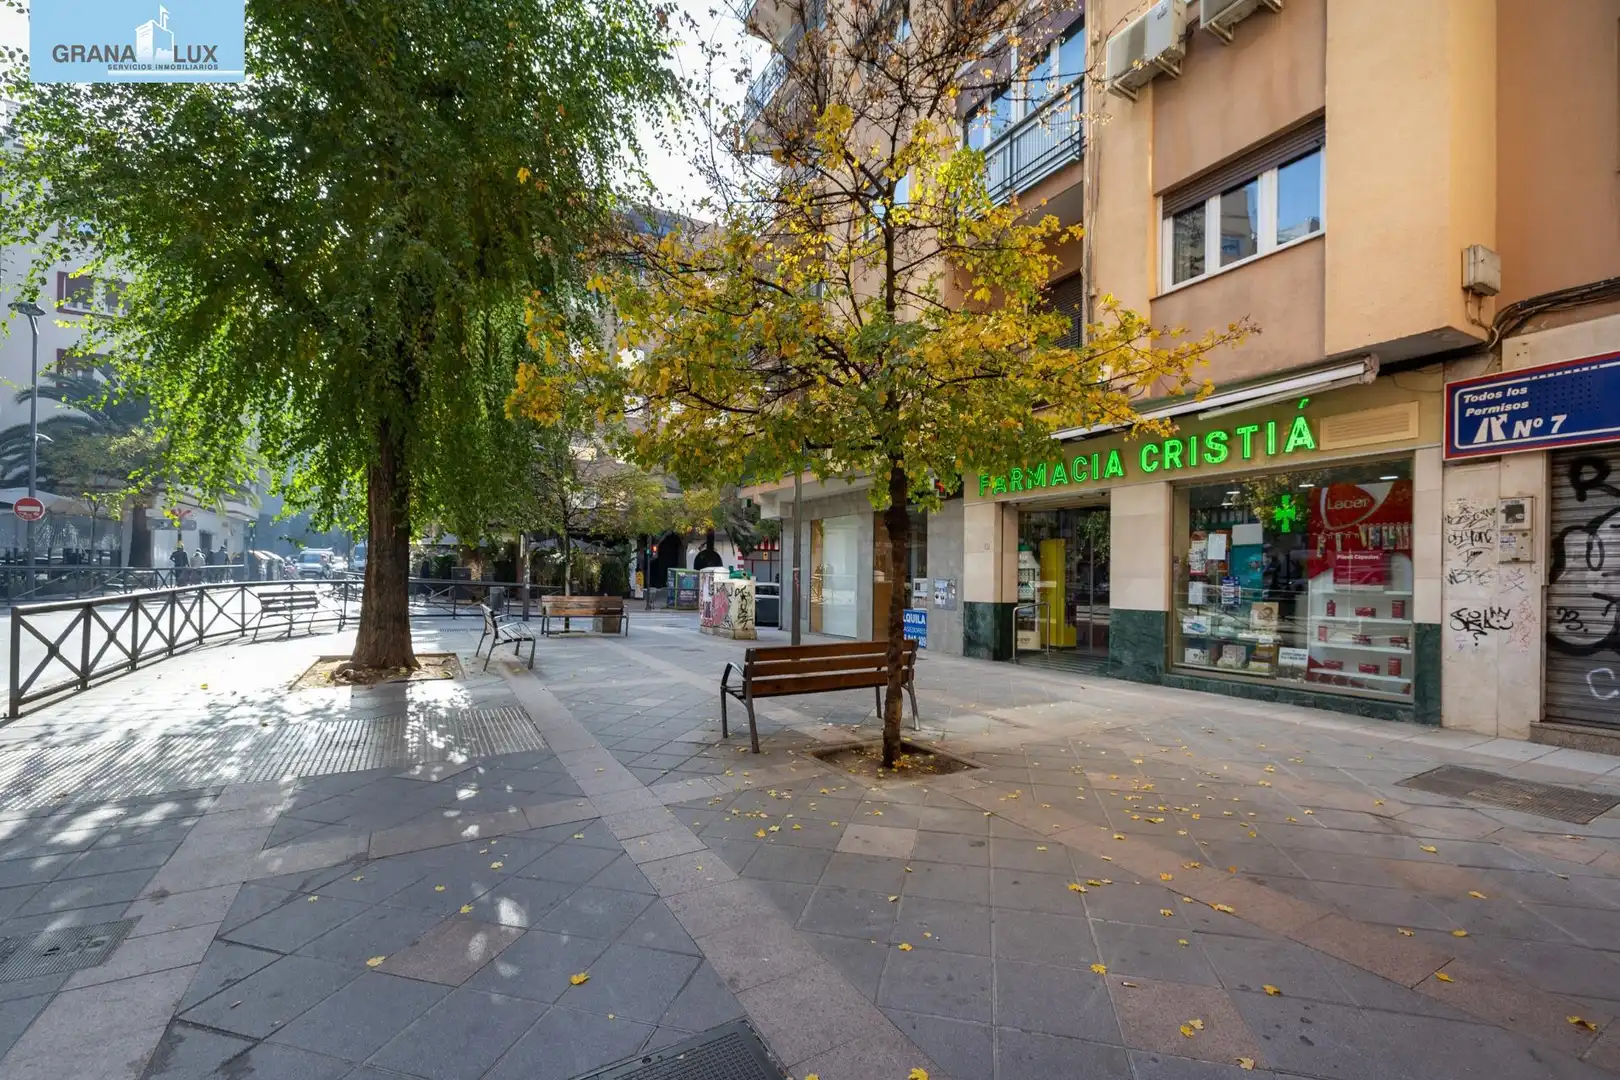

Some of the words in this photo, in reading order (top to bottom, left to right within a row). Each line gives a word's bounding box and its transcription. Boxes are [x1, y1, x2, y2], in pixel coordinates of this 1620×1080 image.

[1464, 389, 1503, 404] Todos
[1507, 387, 1528, 397] los
[1465, 400, 1529, 417] Permisos
[1550, 414, 1567, 434] 7
[979, 449, 1125, 497] FARMACIA
[1140, 398, 1316, 473] CRISTIÁ
[1327, 498, 1370, 510] Lacer
[903, 613, 926, 625] LQUILA
